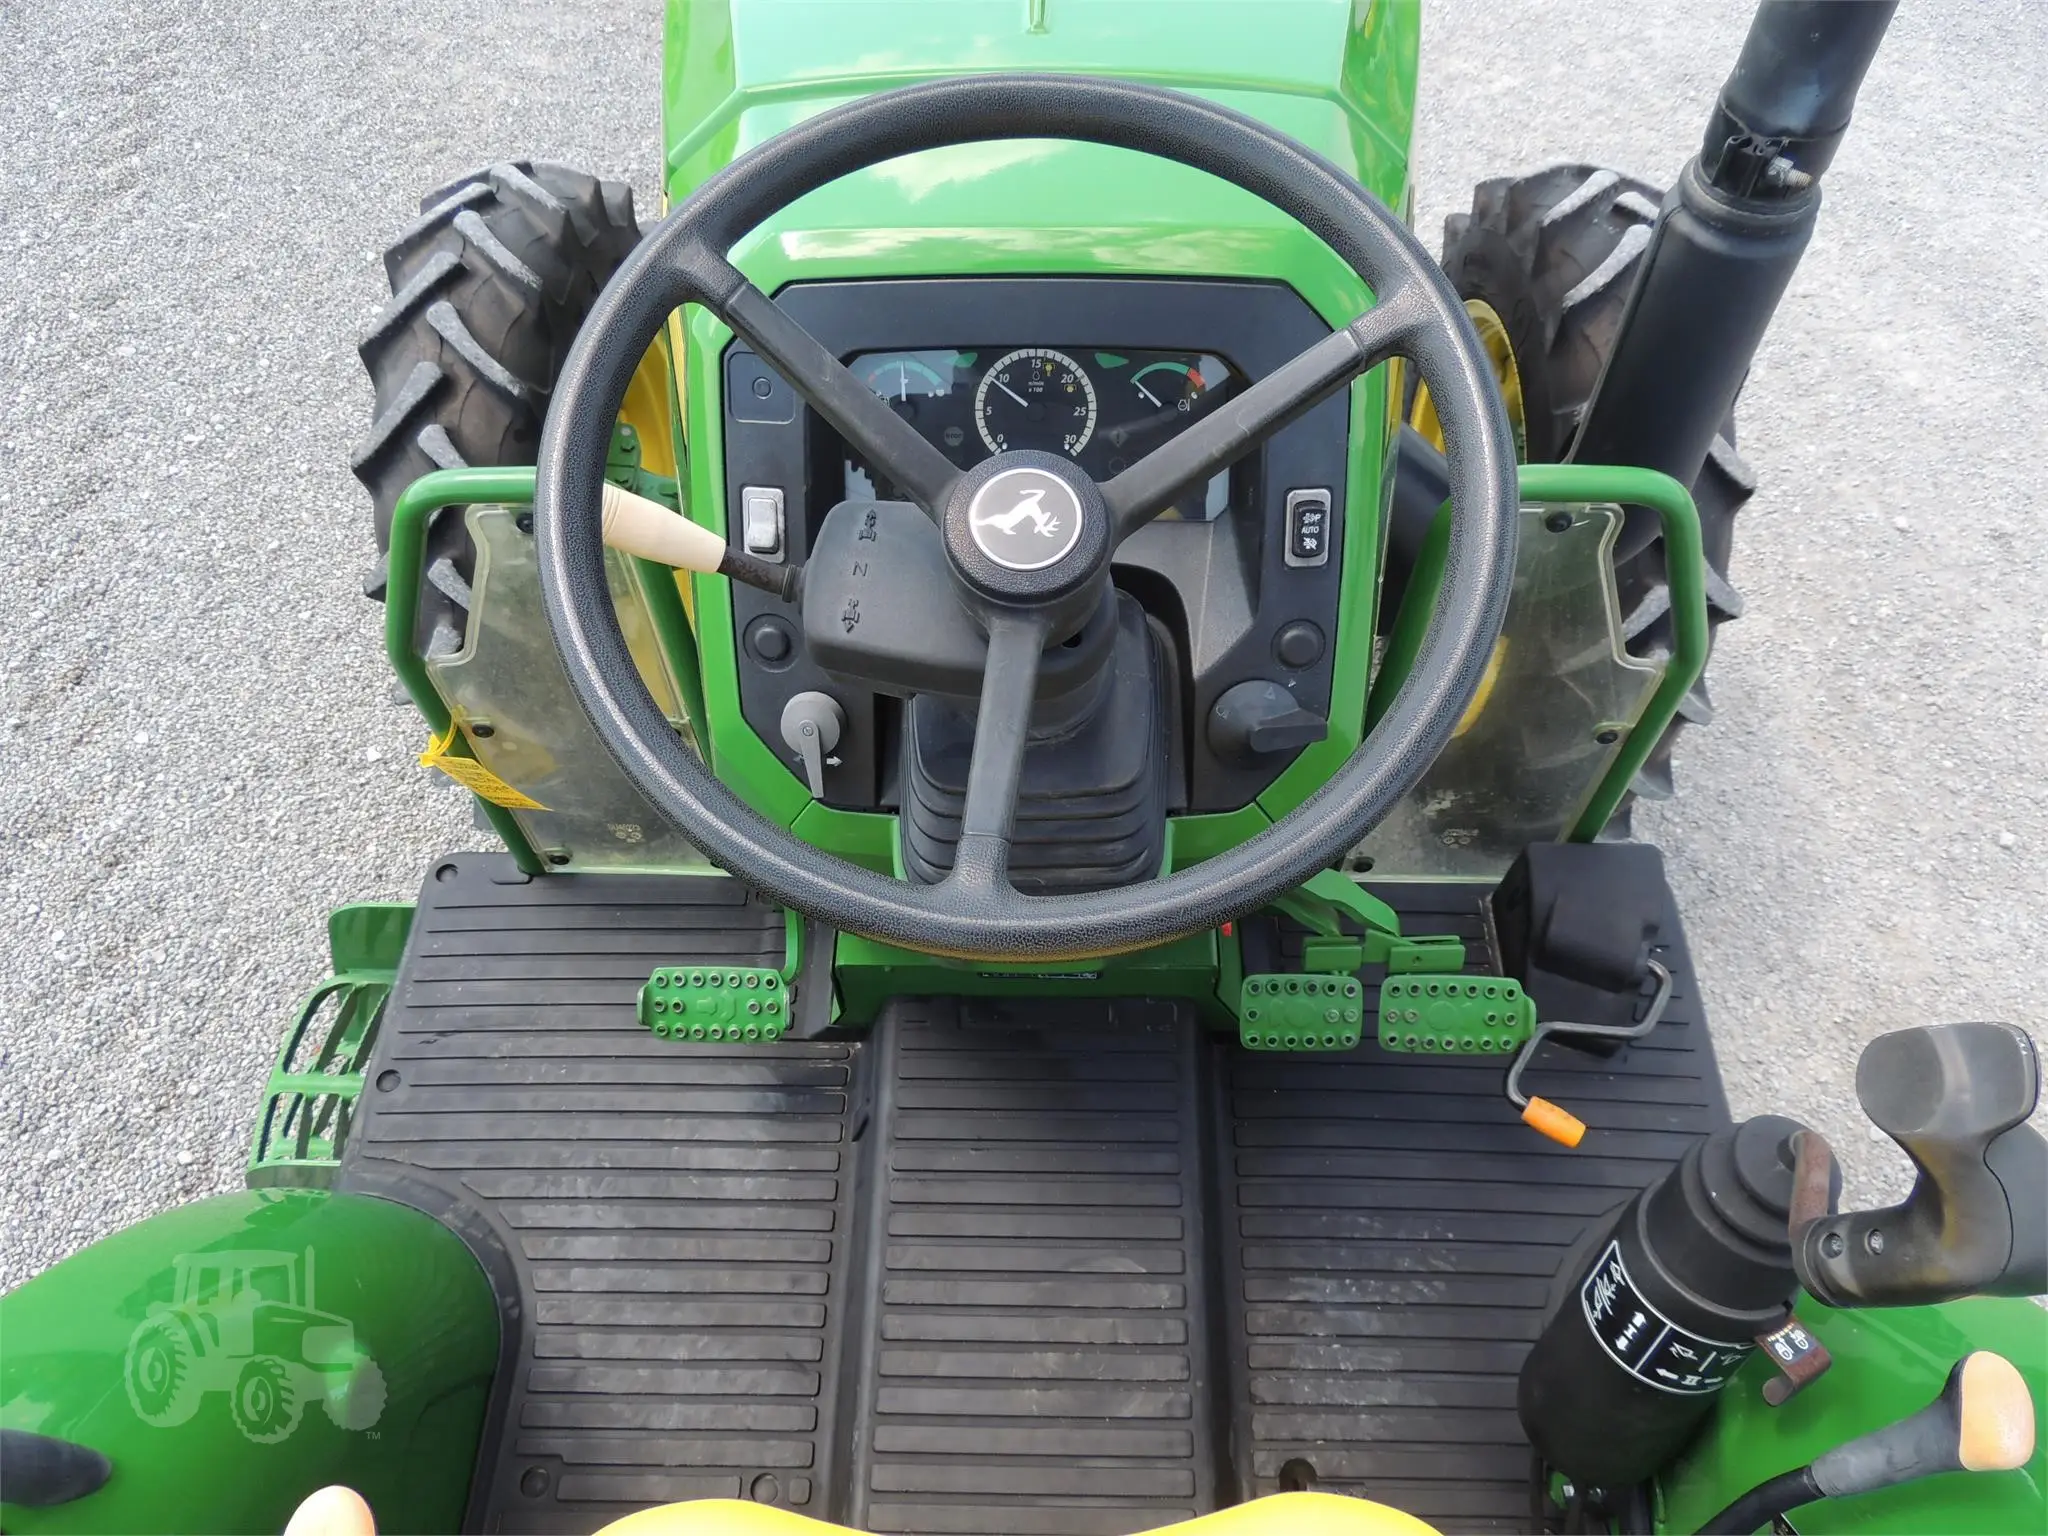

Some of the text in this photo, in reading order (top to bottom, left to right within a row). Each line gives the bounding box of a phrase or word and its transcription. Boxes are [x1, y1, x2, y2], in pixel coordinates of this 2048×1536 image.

[1031, 359, 1041, 368] 15
[999, 374, 1010, 383] 10
[1061, 374, 1074, 383] 20
[985, 406, 992, 415] 5
[1073, 406, 1086, 416] 25
[997, 434, 1004, 442] 0
[1063, 435, 1077, 444] 30
[1301, 526, 1319, 534] AUTO
[852, 562, 868, 576] N
